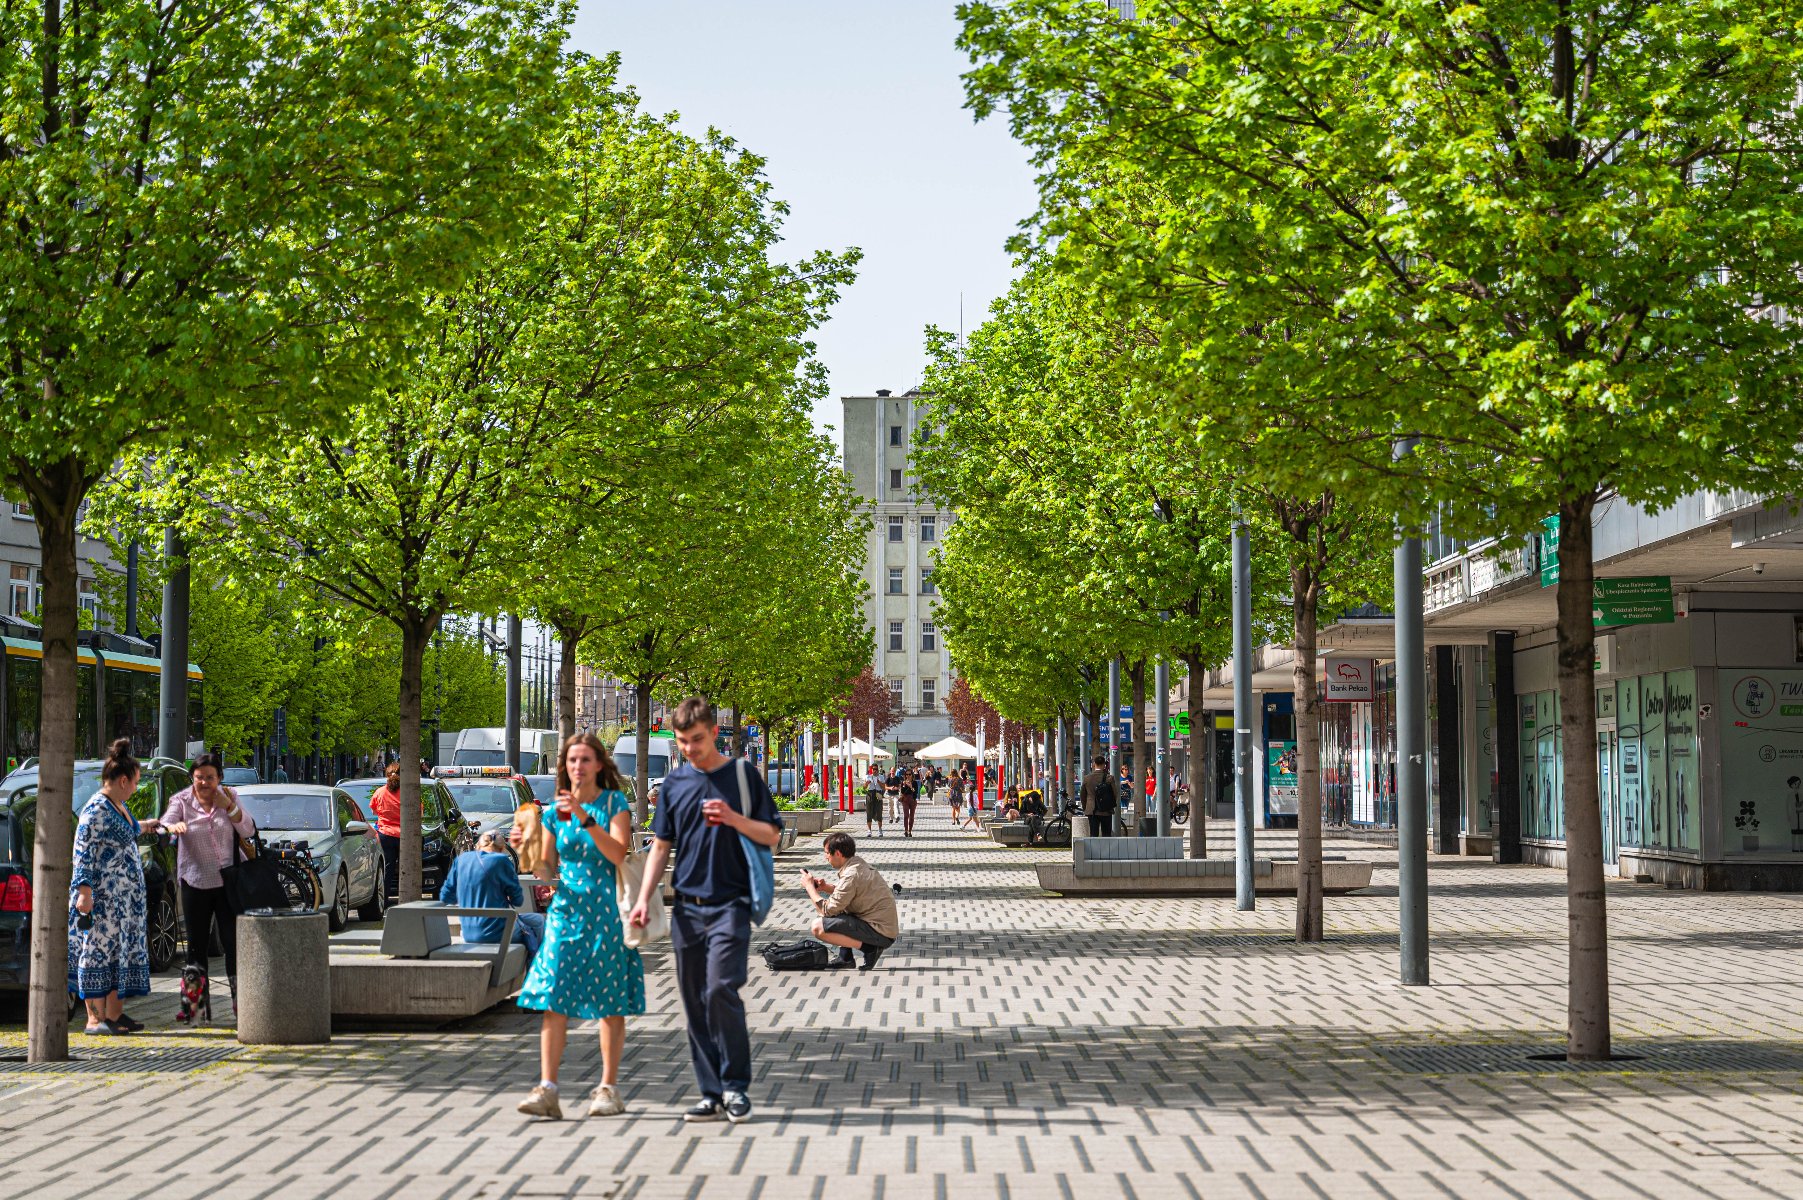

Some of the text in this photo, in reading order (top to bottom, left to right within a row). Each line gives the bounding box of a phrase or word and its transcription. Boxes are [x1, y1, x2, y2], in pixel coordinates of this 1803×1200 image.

[1330, 684, 1368, 692] Bank Pekao
[1781, 682, 1803, 696] TW
[465, 767, 480, 775] TAXI
